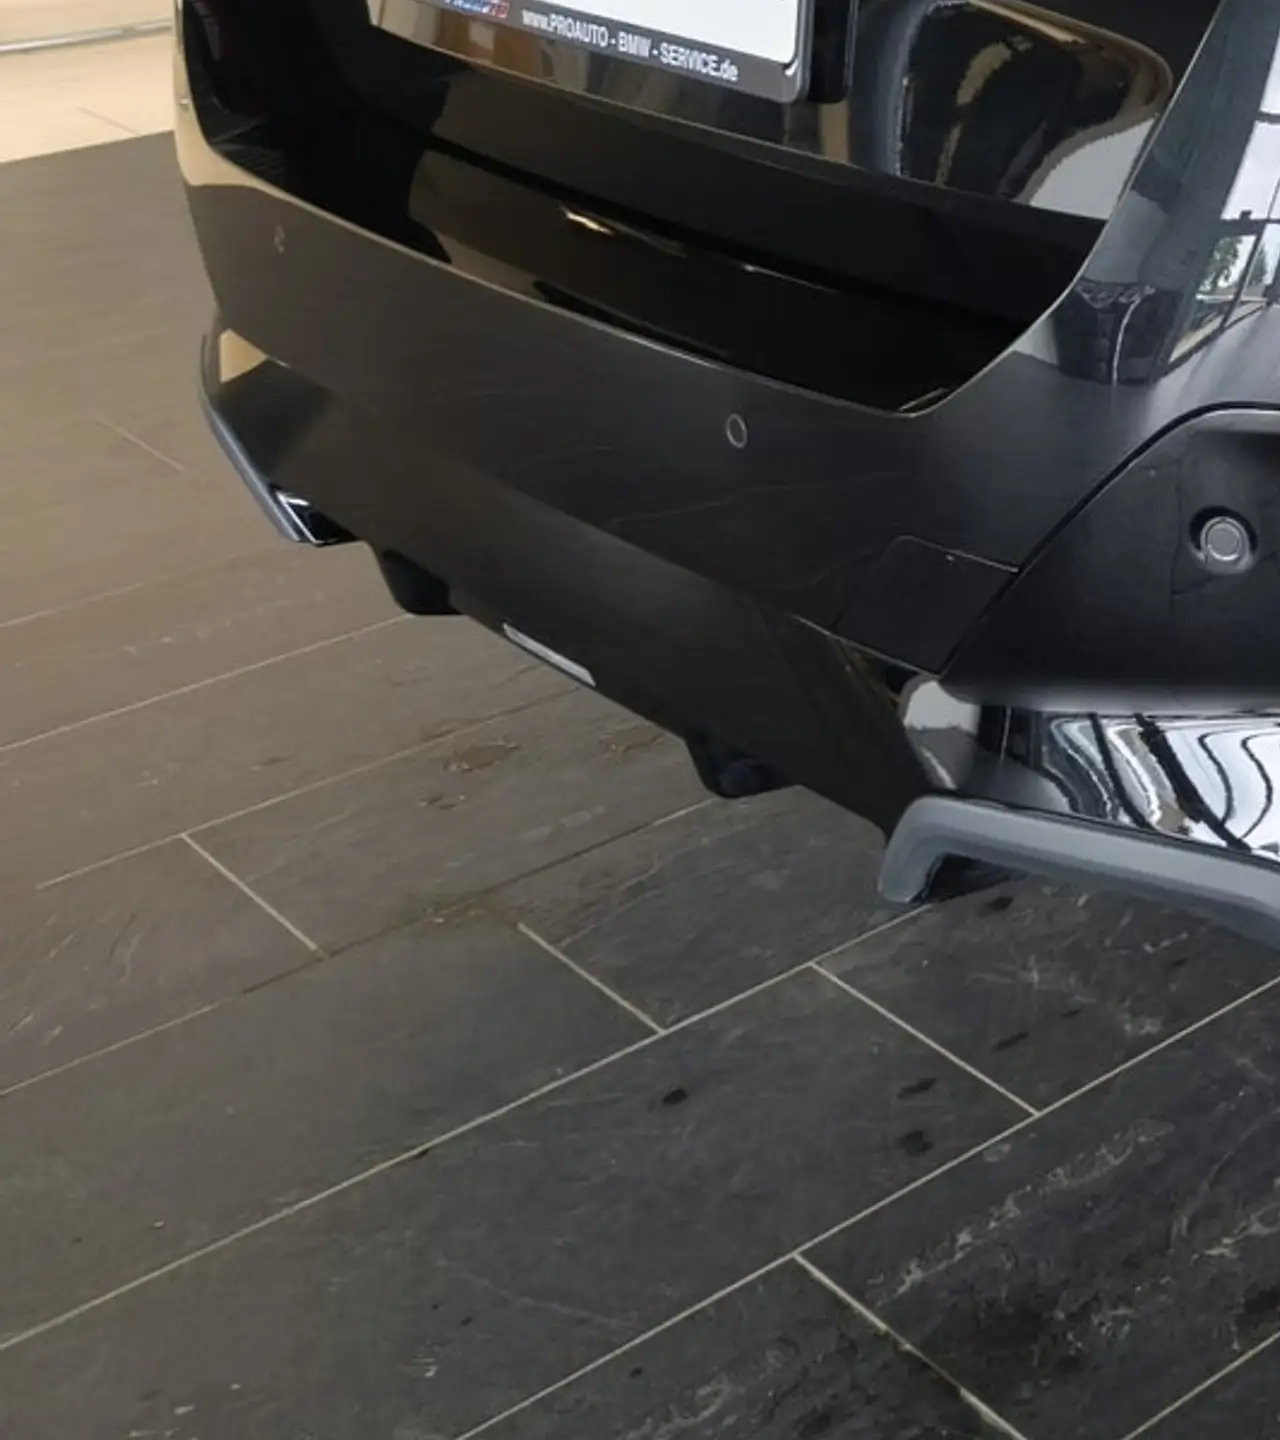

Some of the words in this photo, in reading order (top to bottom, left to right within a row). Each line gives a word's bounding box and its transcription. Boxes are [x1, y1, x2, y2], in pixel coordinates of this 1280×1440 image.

[521, 8, 609, 48] www.PROAUTO
[617, 31, 652, 59] BMW
[659, 41, 740, 83] SERVICE.de
